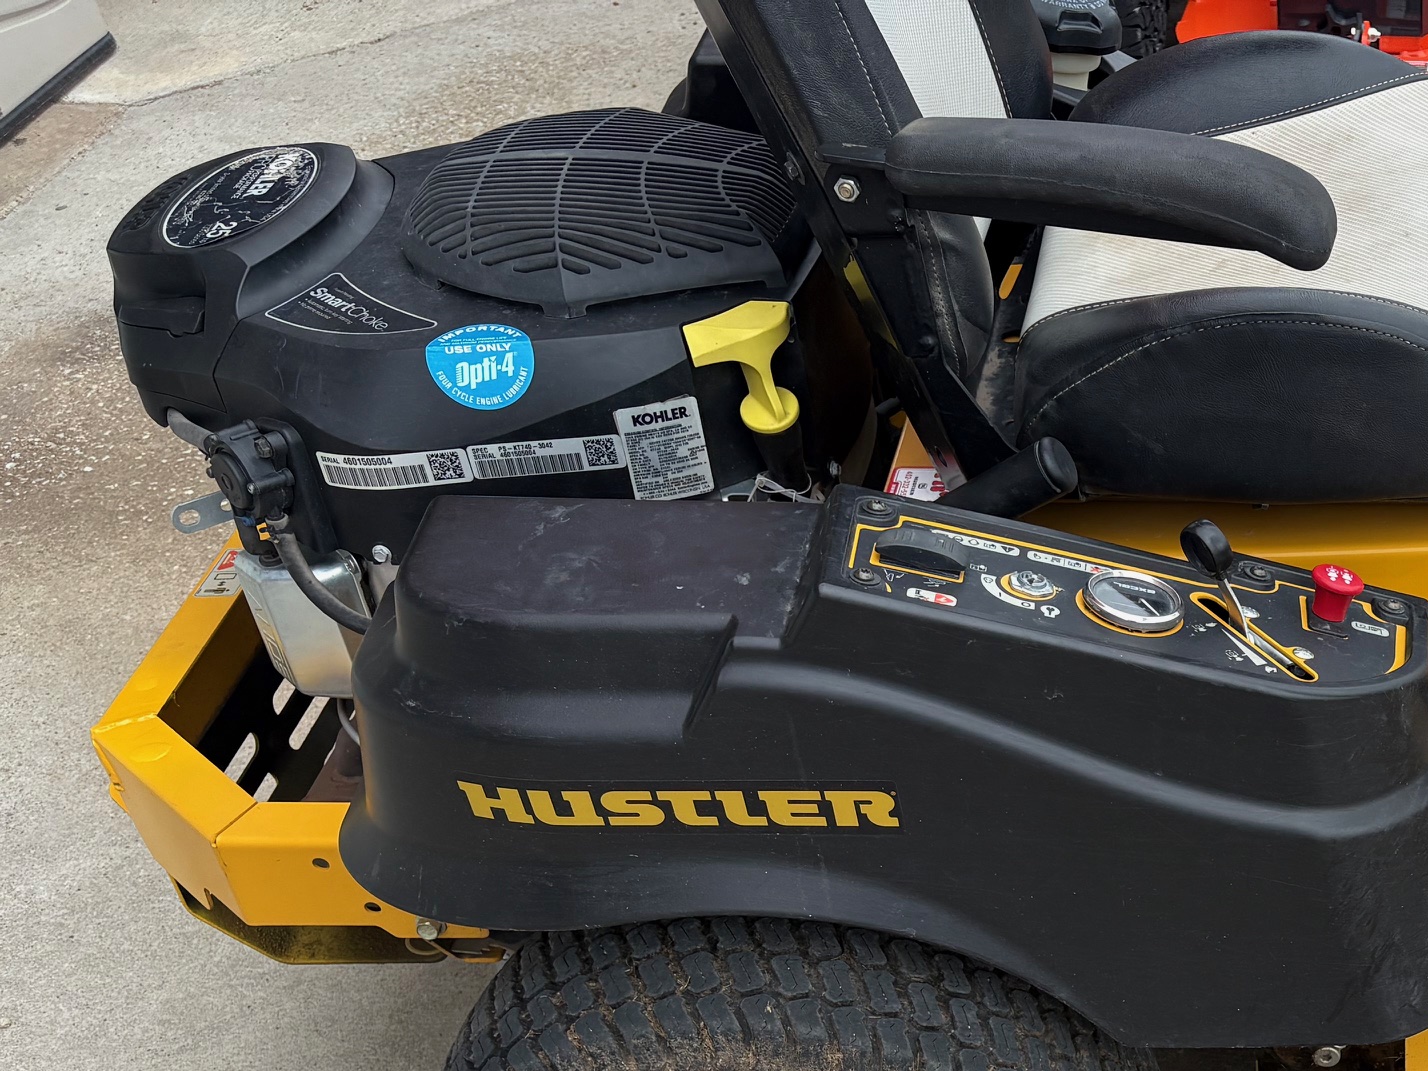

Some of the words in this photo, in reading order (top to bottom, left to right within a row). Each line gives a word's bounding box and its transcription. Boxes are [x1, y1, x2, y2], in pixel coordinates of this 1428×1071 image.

[206, 221, 237, 238] 25
[438, 325, 522, 342] IMPORTANT
[445, 346, 472, 354] USE
[476, 343, 511, 352] ONLY
[456, 352, 514, 390] Opti-4
[436, 371, 452, 389] FOUR
[452, 388, 474, 403] CYCLE
[476, 395, 503, 405] ENGINE
[503, 366, 528, 400] LUBRICANT
[631, 407, 689, 427] KOHLER
[321, 456, 340, 464] SERIAL
[343, 457, 392, 466] 4601505004
[457, 780, 899, 827] HUSTLER
